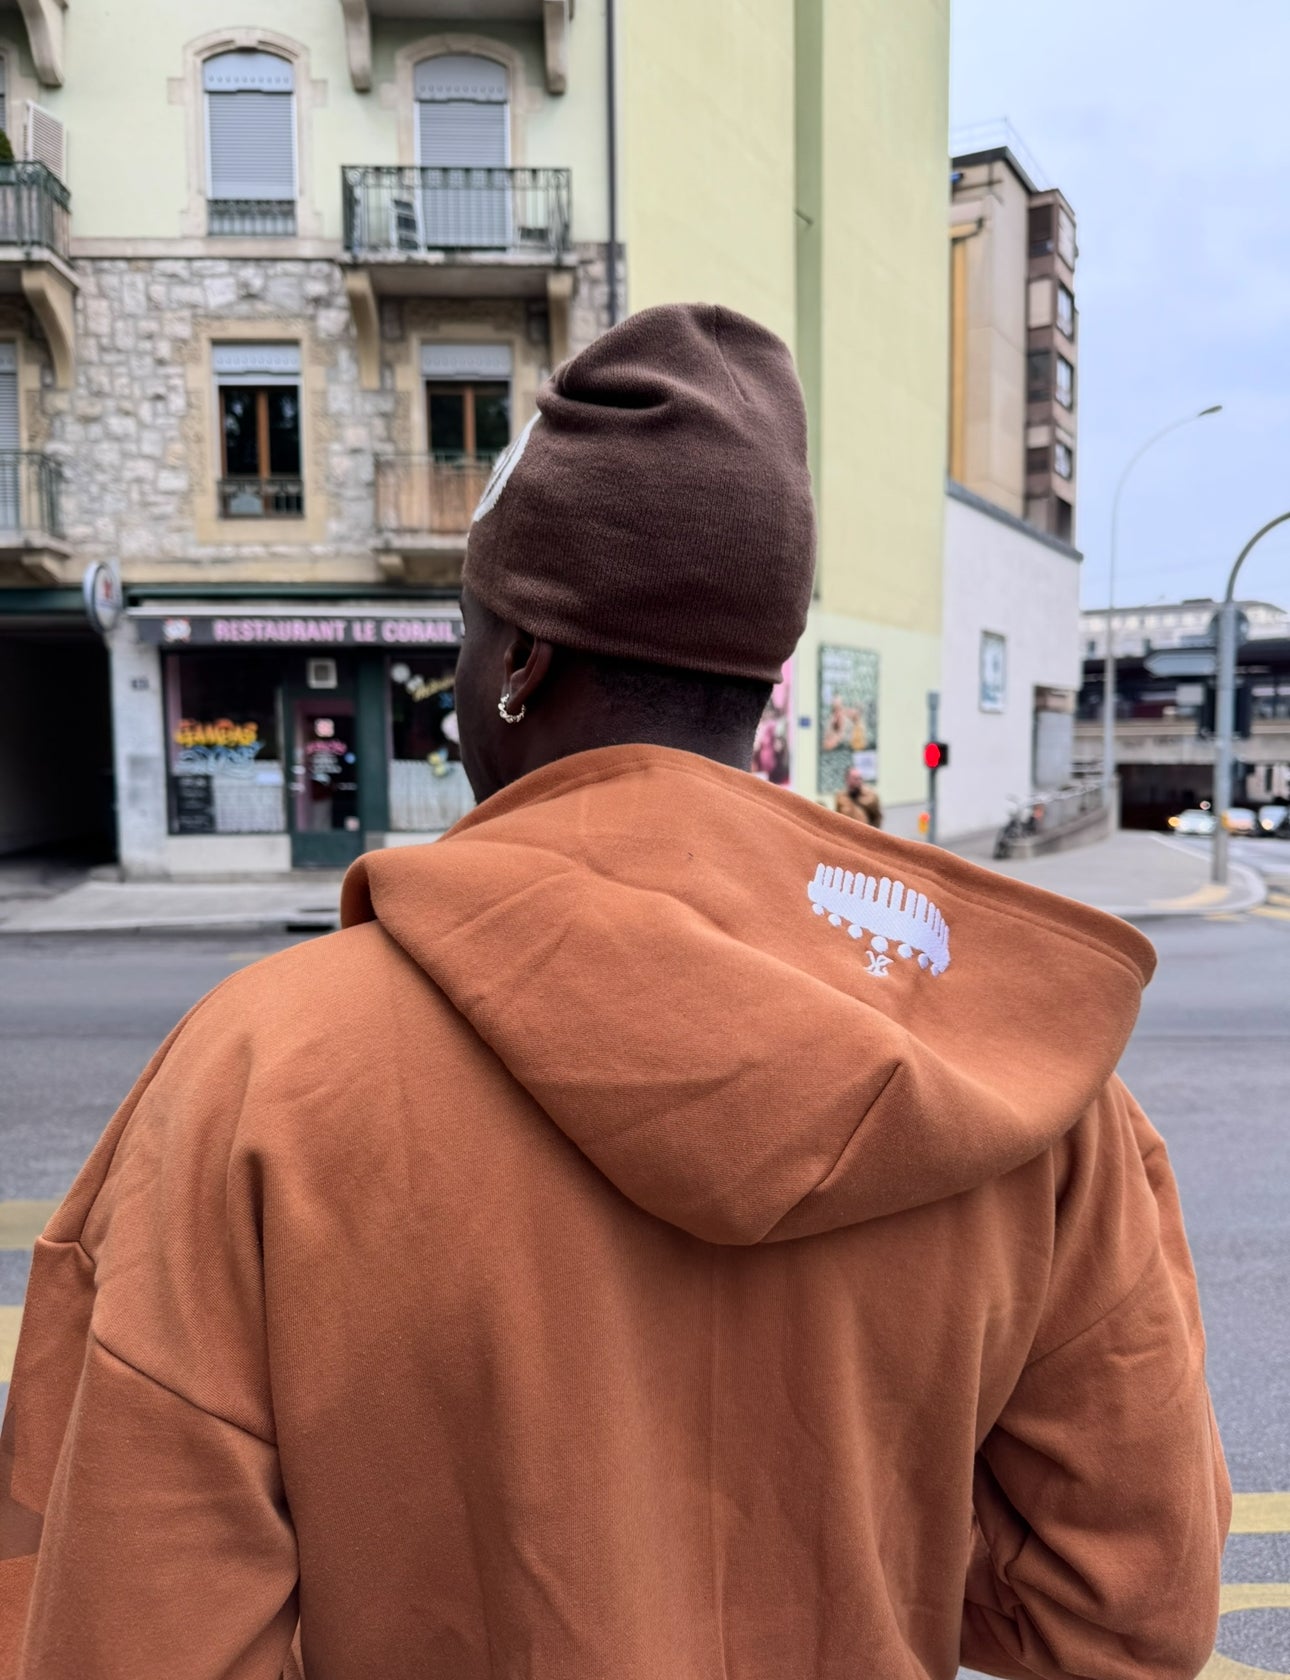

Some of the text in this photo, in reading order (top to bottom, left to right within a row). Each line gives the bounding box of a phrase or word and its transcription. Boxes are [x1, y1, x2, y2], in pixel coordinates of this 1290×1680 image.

[214, 619, 457, 642] RESTAURANT LE CORAIL
